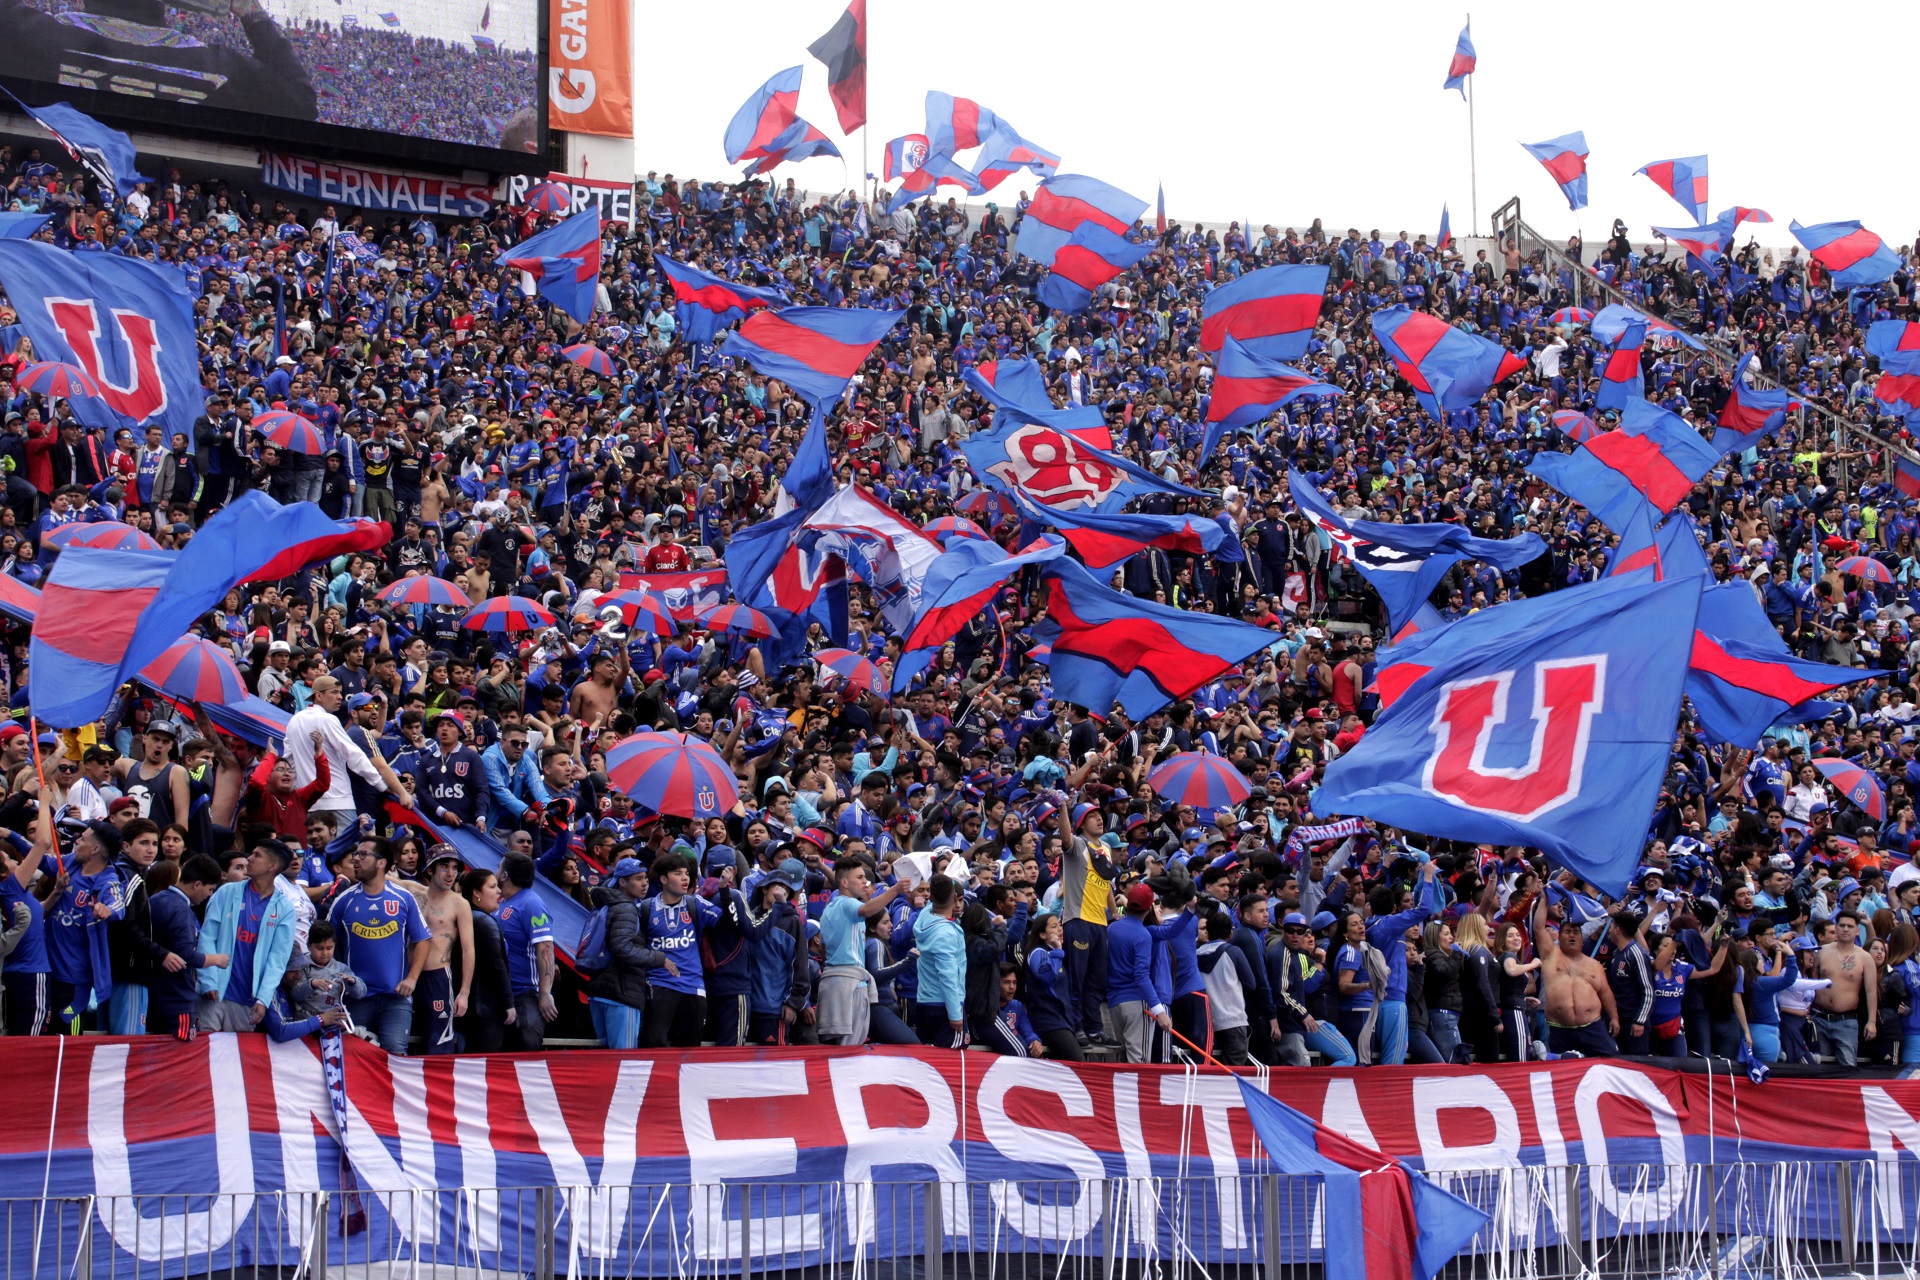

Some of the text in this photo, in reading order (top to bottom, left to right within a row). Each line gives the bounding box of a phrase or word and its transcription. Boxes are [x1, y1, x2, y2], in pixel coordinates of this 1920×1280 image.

[262, 151, 490, 218] INFERNALES
[508, 173, 530, 207] R
[43, 296, 168, 426] U
[655, 560, 678, 570] Claro
[600, 604, 627, 640] 2
[1420, 653, 1609, 823] U
[455, 762, 469, 777] U
[699, 791, 715, 812] U
[384, 900, 399, 916] U
[680, 911, 692, 924] U
[354, 925, 398, 939] CRISTAL
[651, 929, 695, 950] Claro
[1654, 987, 1684, 997] Claro
[433, 1000, 444, 1011] U
